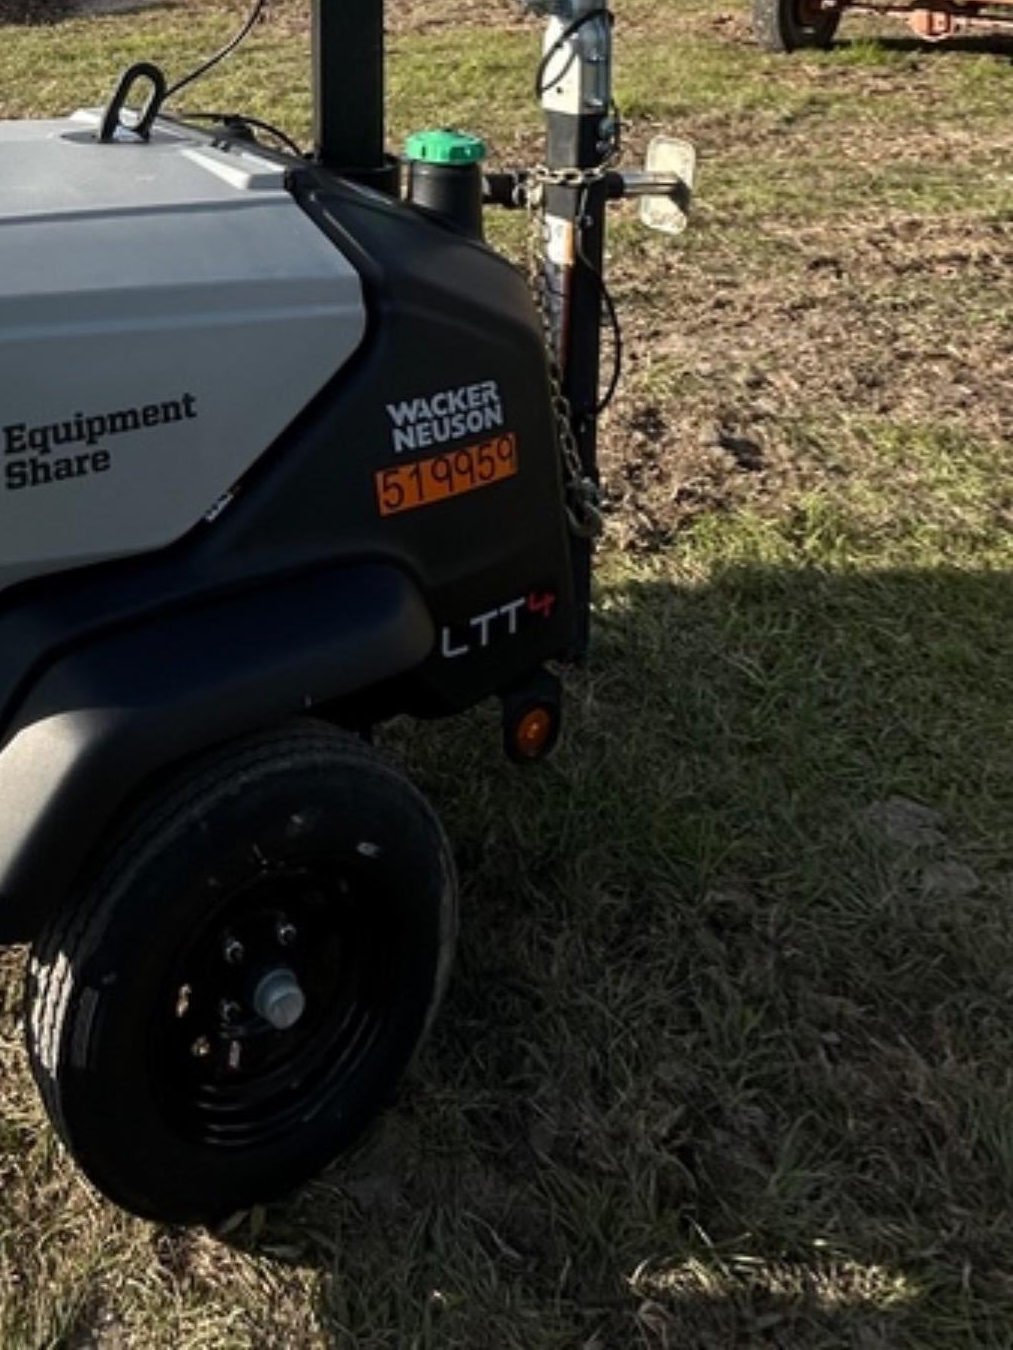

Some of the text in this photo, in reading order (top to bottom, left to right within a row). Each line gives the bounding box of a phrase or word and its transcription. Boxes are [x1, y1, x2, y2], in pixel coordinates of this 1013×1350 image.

[2, 392, 197, 455] Equipment
[386, 380, 500, 427] WACKER
[393, 404, 504, 453] NEUSON
[5, 450, 111, 491] Share
